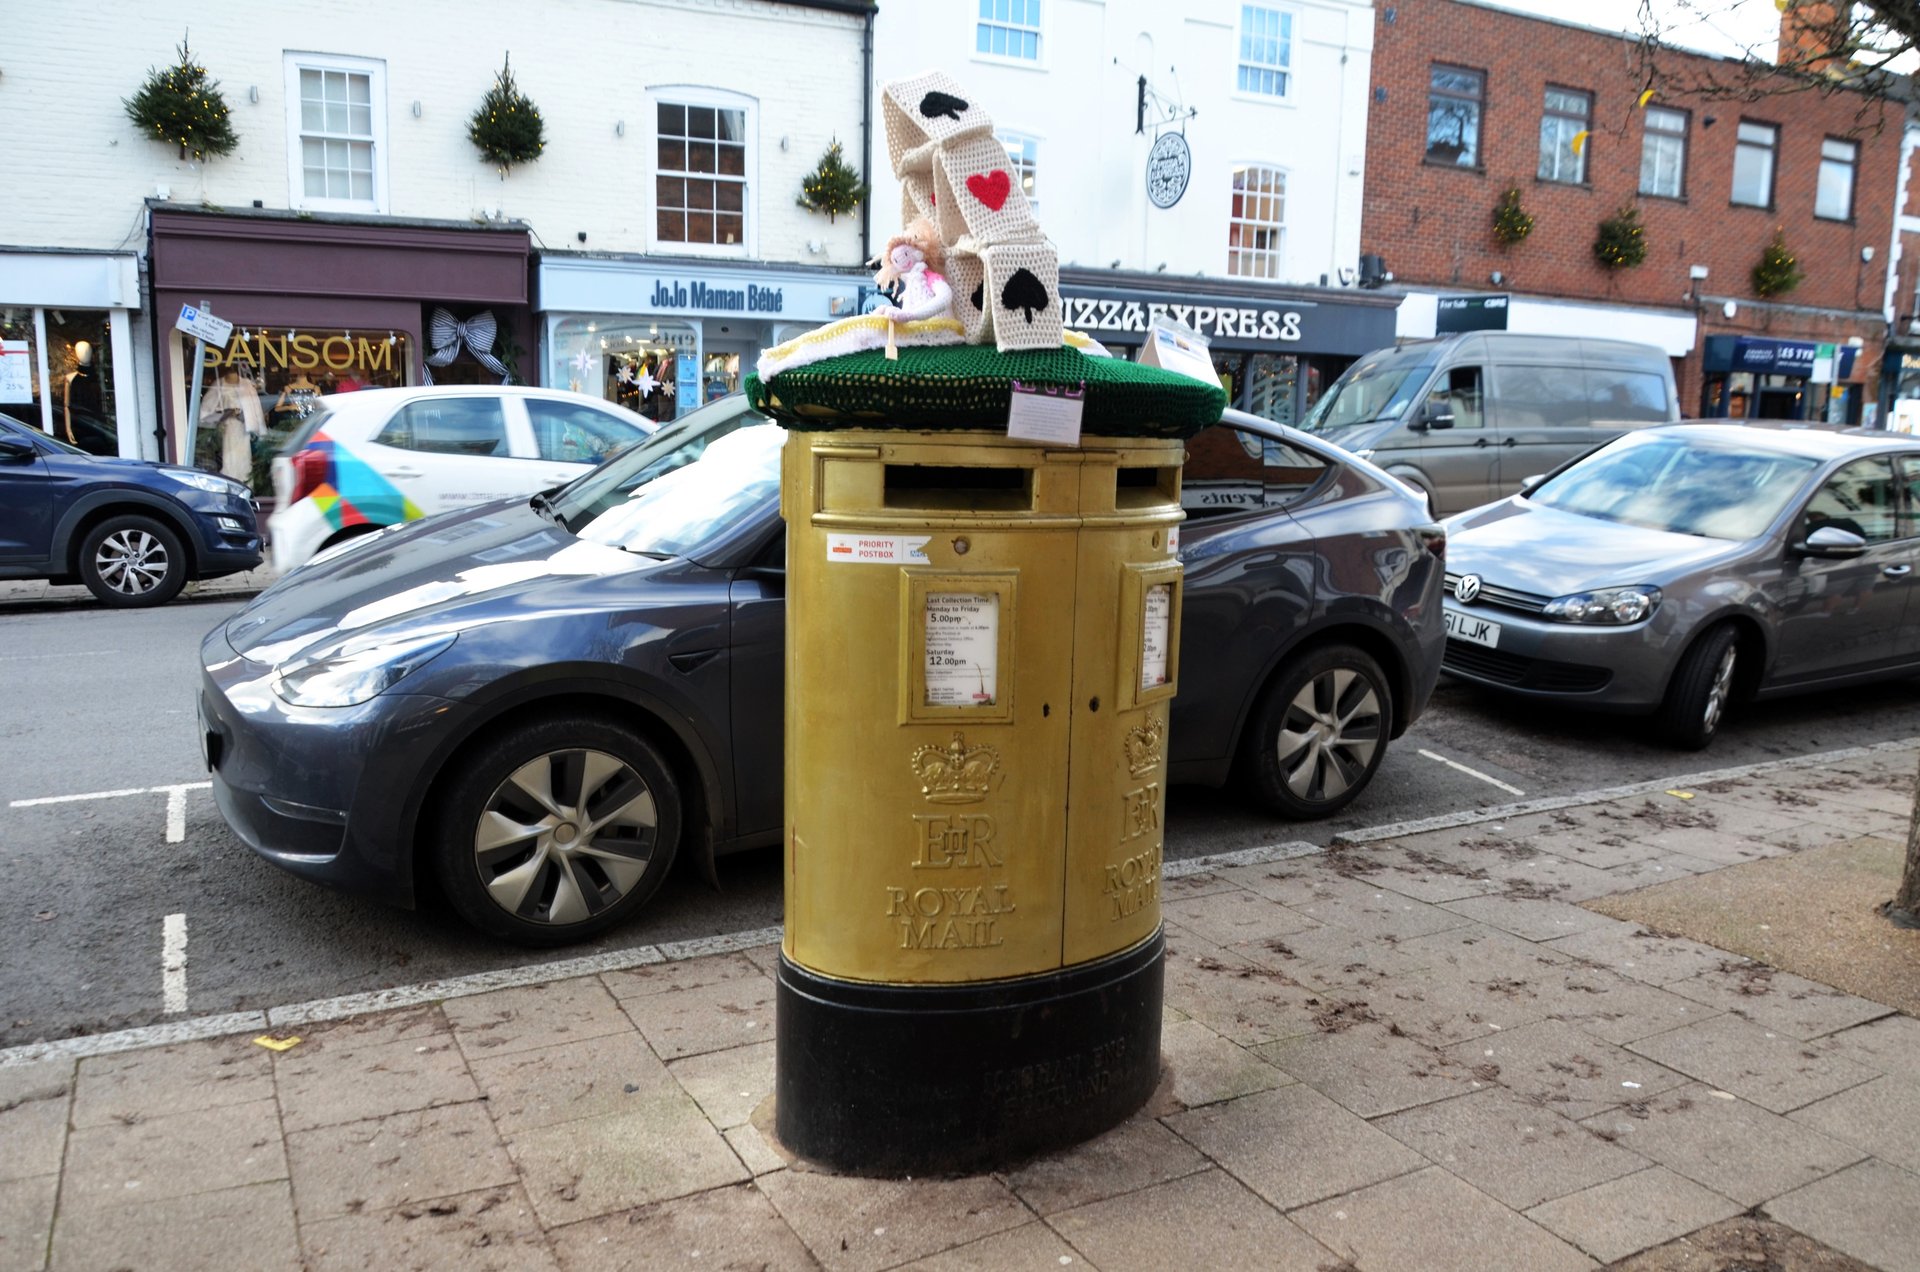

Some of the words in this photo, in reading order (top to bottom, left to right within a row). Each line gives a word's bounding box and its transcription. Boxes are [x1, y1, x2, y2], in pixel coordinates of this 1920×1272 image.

[651, 279, 687, 308] JoJo
[691, 281, 745, 311] Maman
[748, 284, 783, 312] Bébé
[1060, 297, 1301, 341] IZZAEXPRESS
[859, 540, 893, 548] PRIORITY
[931, 613, 961, 623] 5.00pm
[1459, 617, 1490, 641] LJK
[929, 656, 967, 666] 12.00pm
[886, 885, 1016, 918] ROYAL
[901, 918, 1004, 950] MAIL
